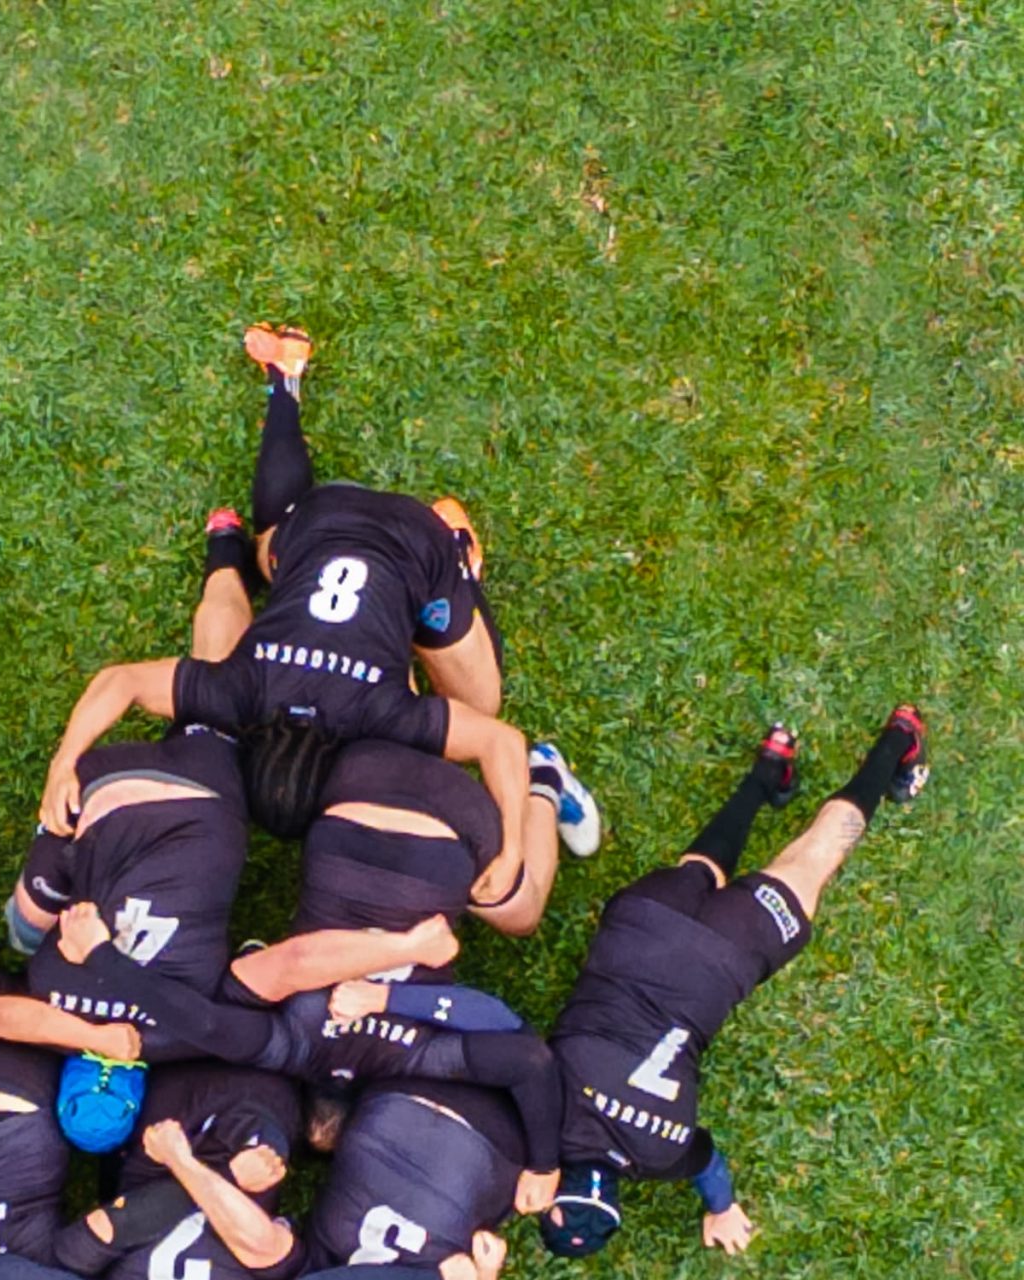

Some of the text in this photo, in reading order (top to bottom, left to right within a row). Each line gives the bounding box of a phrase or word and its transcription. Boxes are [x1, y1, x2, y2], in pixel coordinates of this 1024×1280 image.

[308, 556, 369, 624] 8
[106, 896, 180, 967] 4
[627, 1027, 690, 1102] 7
